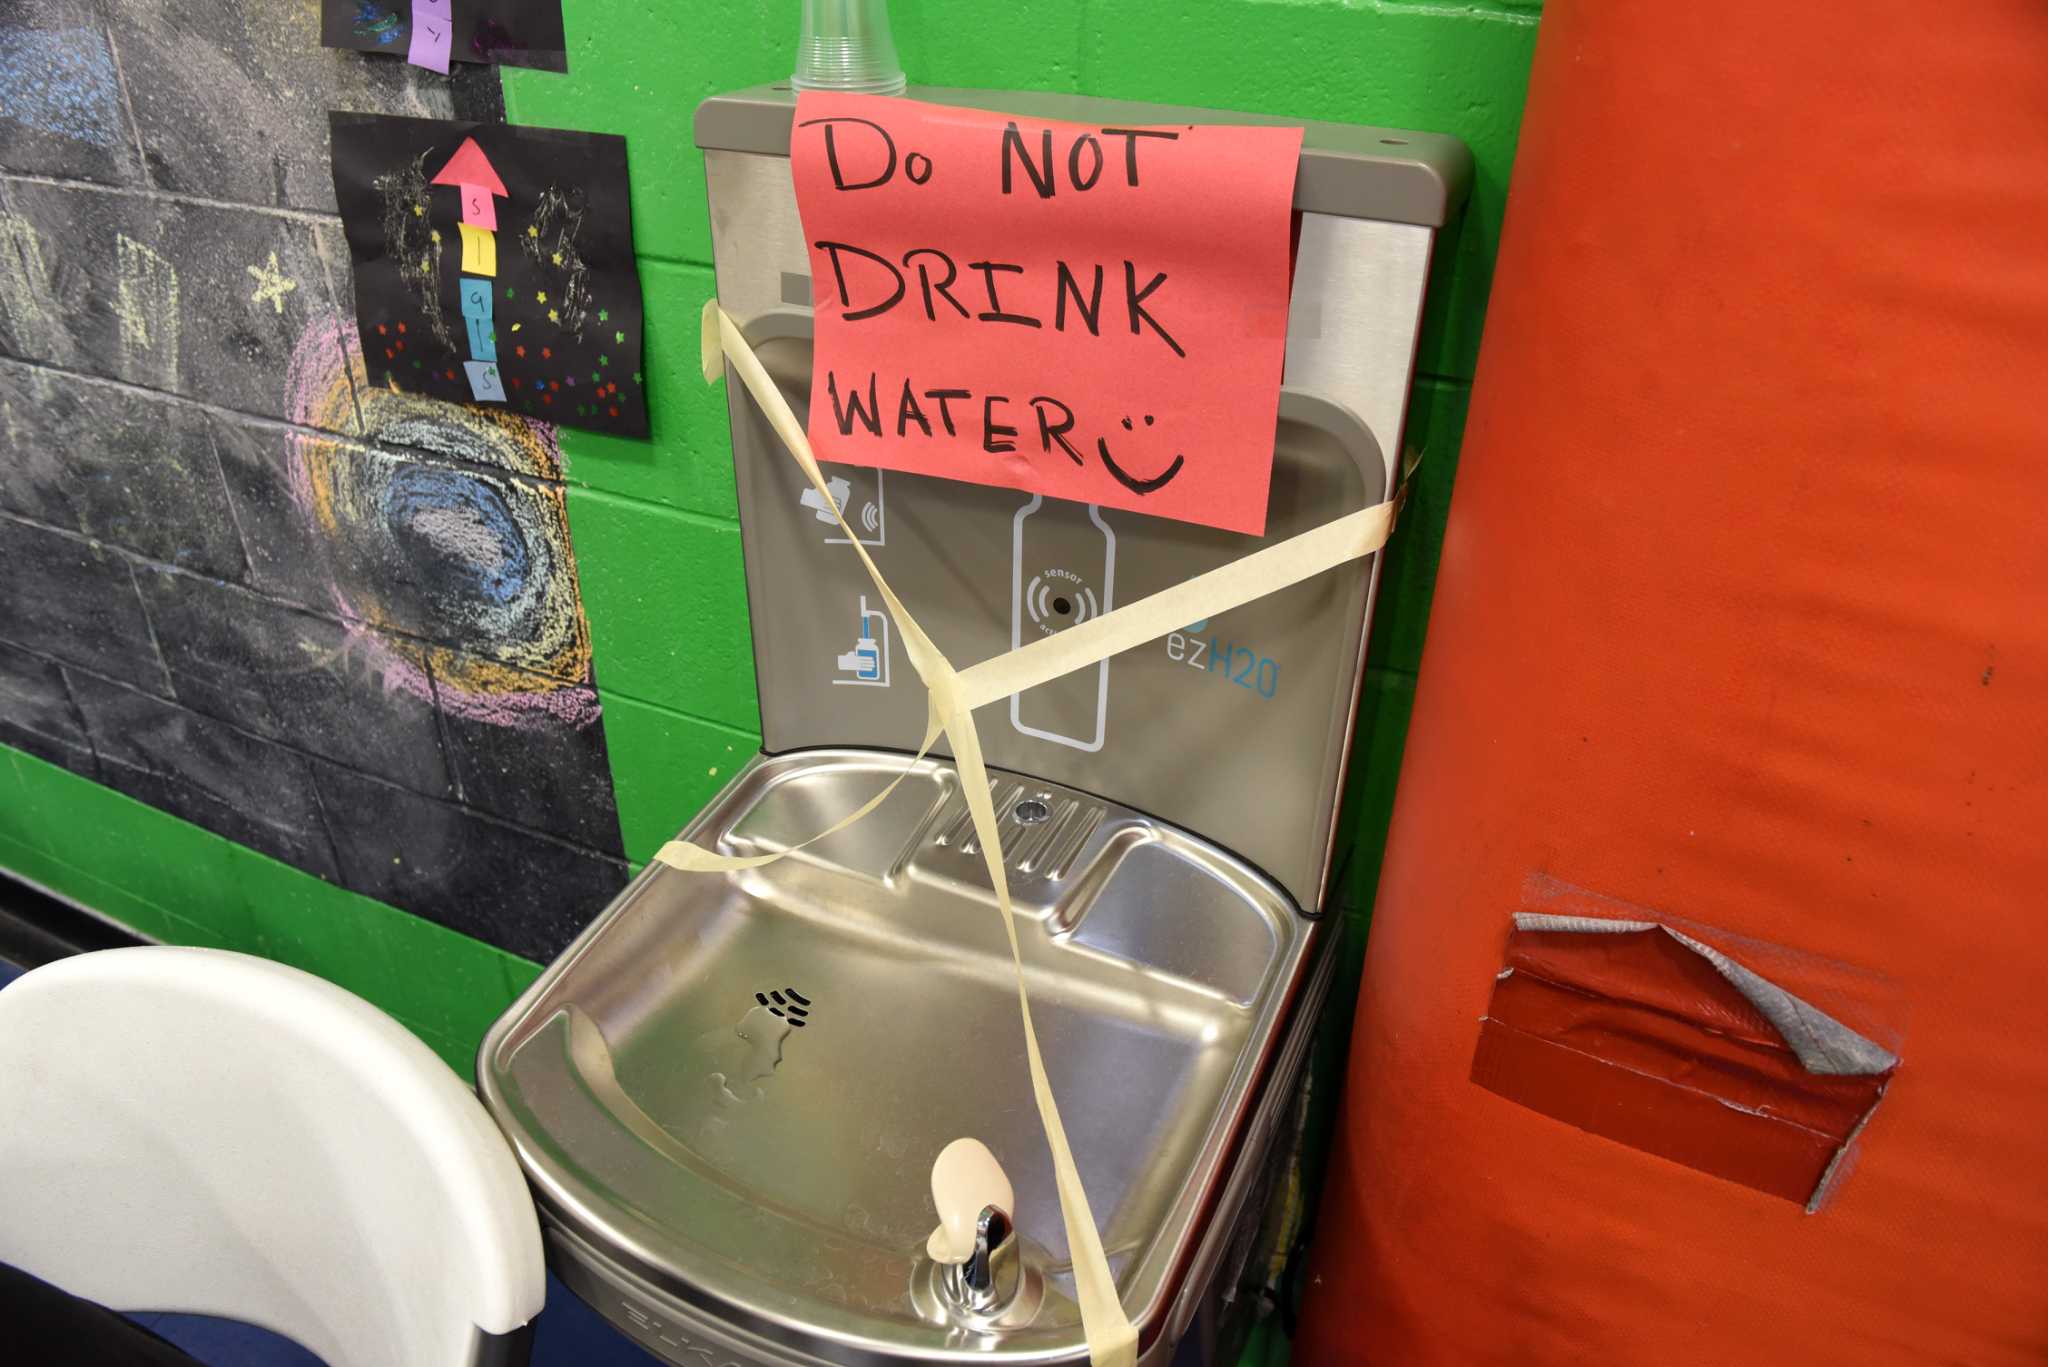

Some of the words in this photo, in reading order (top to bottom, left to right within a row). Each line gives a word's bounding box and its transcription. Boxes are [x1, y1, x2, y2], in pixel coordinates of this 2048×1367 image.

[1001, 121, 1180, 198] NOT
[814, 240, 1186, 358] DRINK
[827, 370, 1084, 466] WATER
[1043, 568, 1083, 585] sensor
